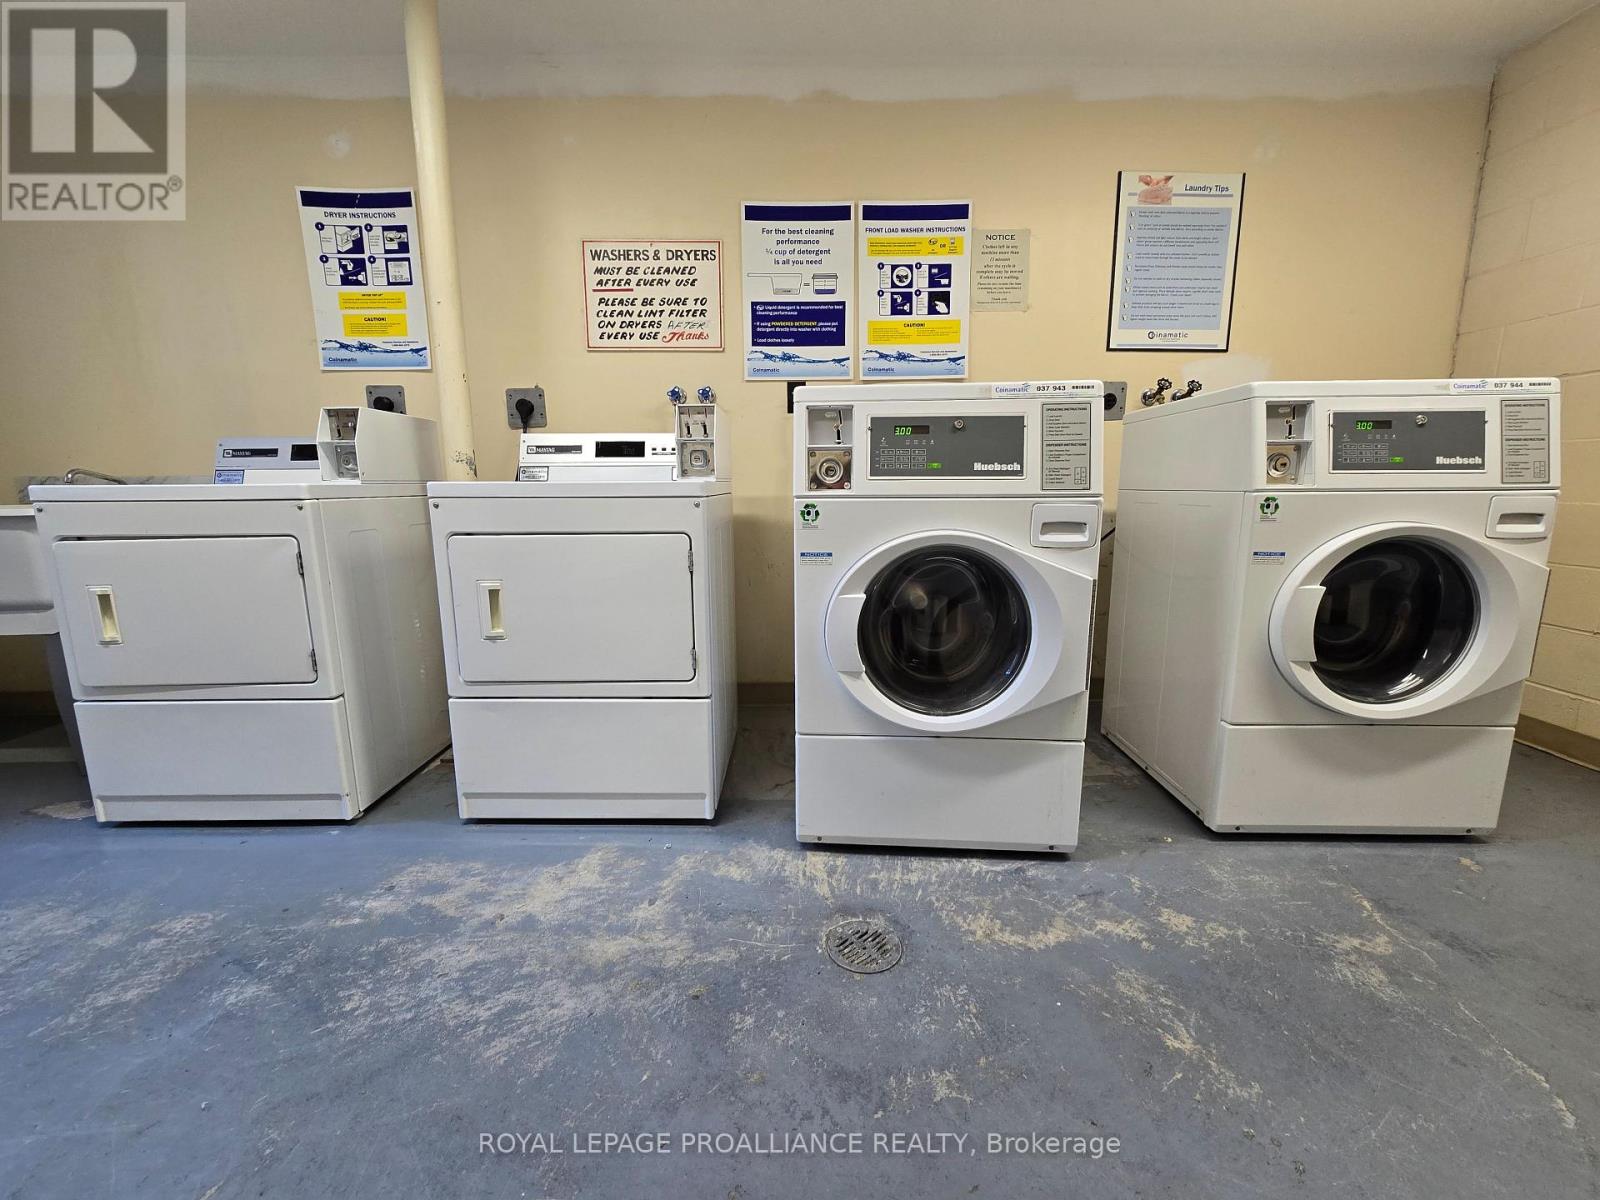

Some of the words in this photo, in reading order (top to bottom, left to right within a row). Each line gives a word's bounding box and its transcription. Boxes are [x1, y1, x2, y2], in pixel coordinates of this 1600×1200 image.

[1184, 184, 1212, 193] Laundry
[1214, 184, 1230, 192] Tips
[804, 228, 834, 236] cleaning
[590, 249, 650, 261] WASHERS
[652, 250, 660, 261] &
[666, 249, 716, 261] DRYERS
[797, 248, 831, 256] detergent
[594, 266, 622, 276] MUST
[626, 266, 640, 275] BE
[643, 266, 696, 275] CLEANED
[596, 278, 632, 287] AFTER
[636, 278, 670, 287] EVERY
[675, 278, 698, 287] USE
[598, 297, 638, 306] PLEASE
[641, 297, 656, 306] BE
[659, 297, 689, 306] SURE
[693, 297, 708, 306] TO
[596, 309, 634, 318] CLEAN
[637, 309, 665, 318] LINT
[668, 309, 708, 318] FILTER
[598, 320, 616, 329] ON
[619, 320, 662, 329] DRYERS
[667, 321, 706, 330] AFTER
[599, 332, 634, 340] EVERY
[639, 332, 660, 340] USE
[662, 331, 709, 343] Thanks
[1436, 456, 1482, 464] Huebsch
[974, 462, 1021, 471] Huebsch
